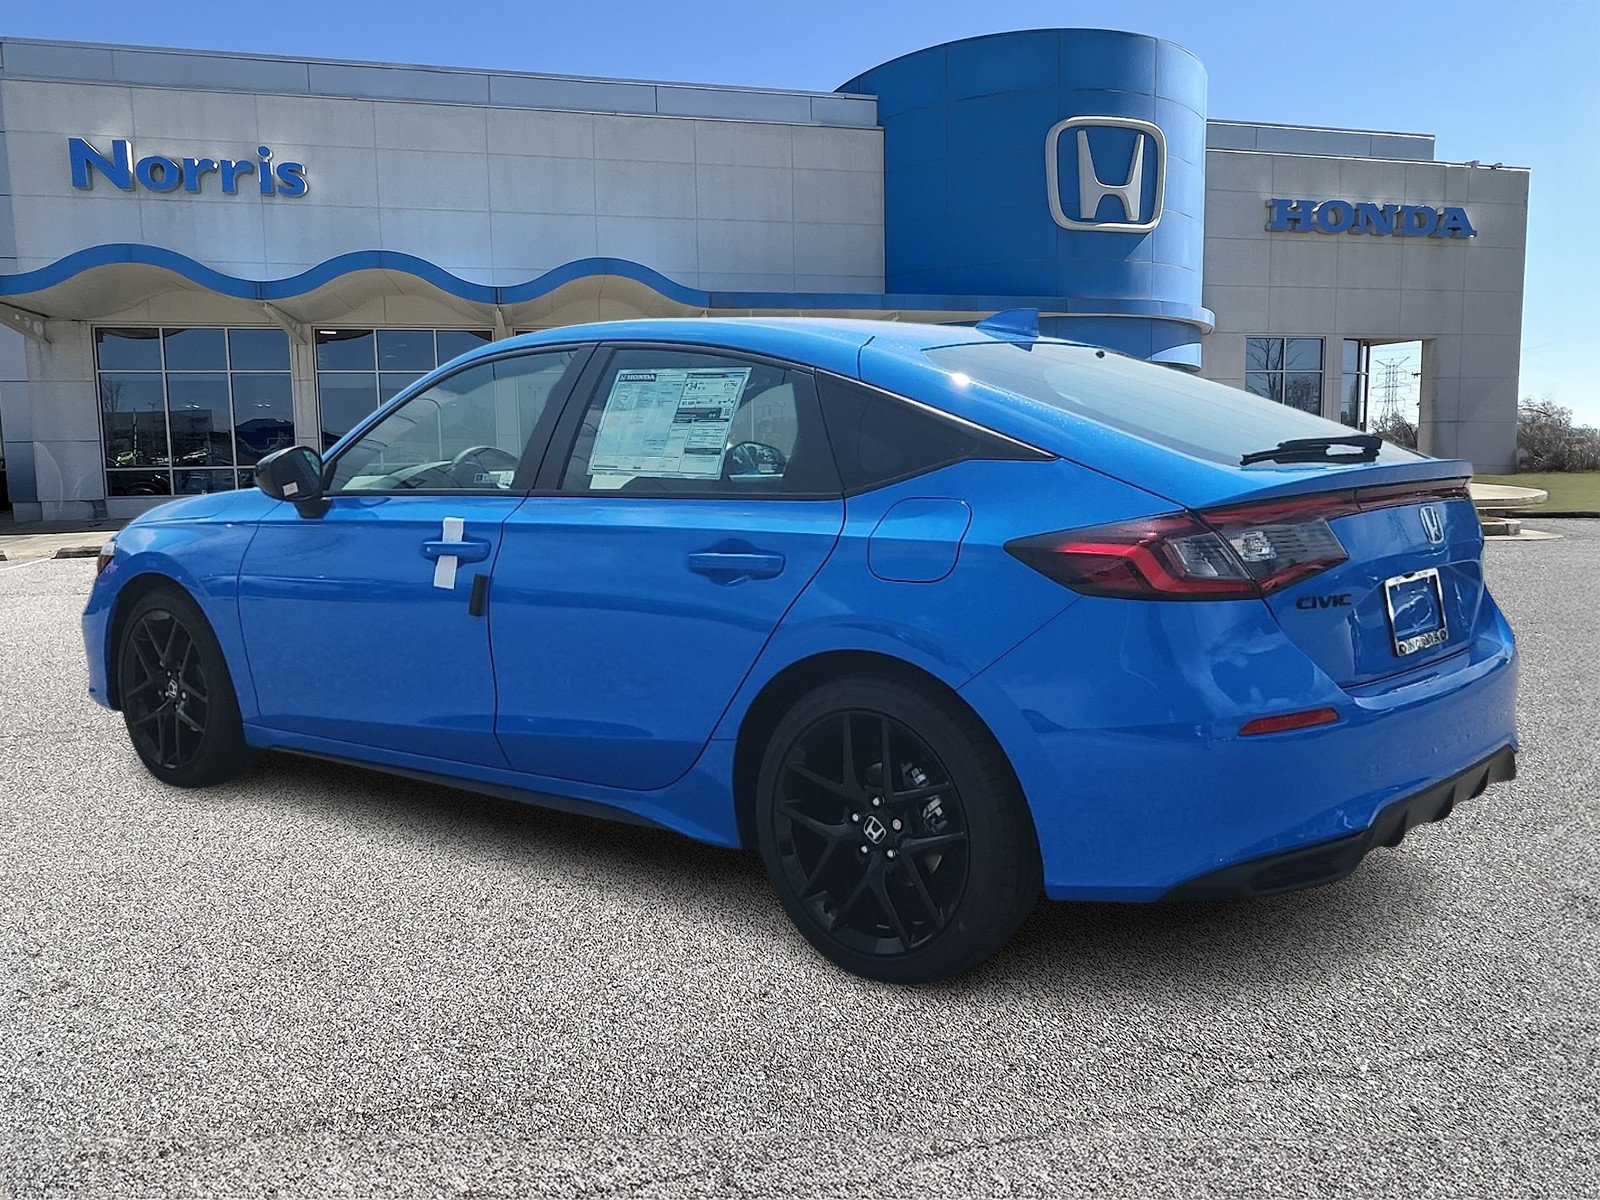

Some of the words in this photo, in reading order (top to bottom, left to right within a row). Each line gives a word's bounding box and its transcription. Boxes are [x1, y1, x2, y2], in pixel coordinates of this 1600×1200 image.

[68, 137, 308, 197] Norris
[1265, 198, 1477, 239] HONDA
[626, 373, 656, 381] HONDA
[1296, 593, 1352, 609] CIVIC
